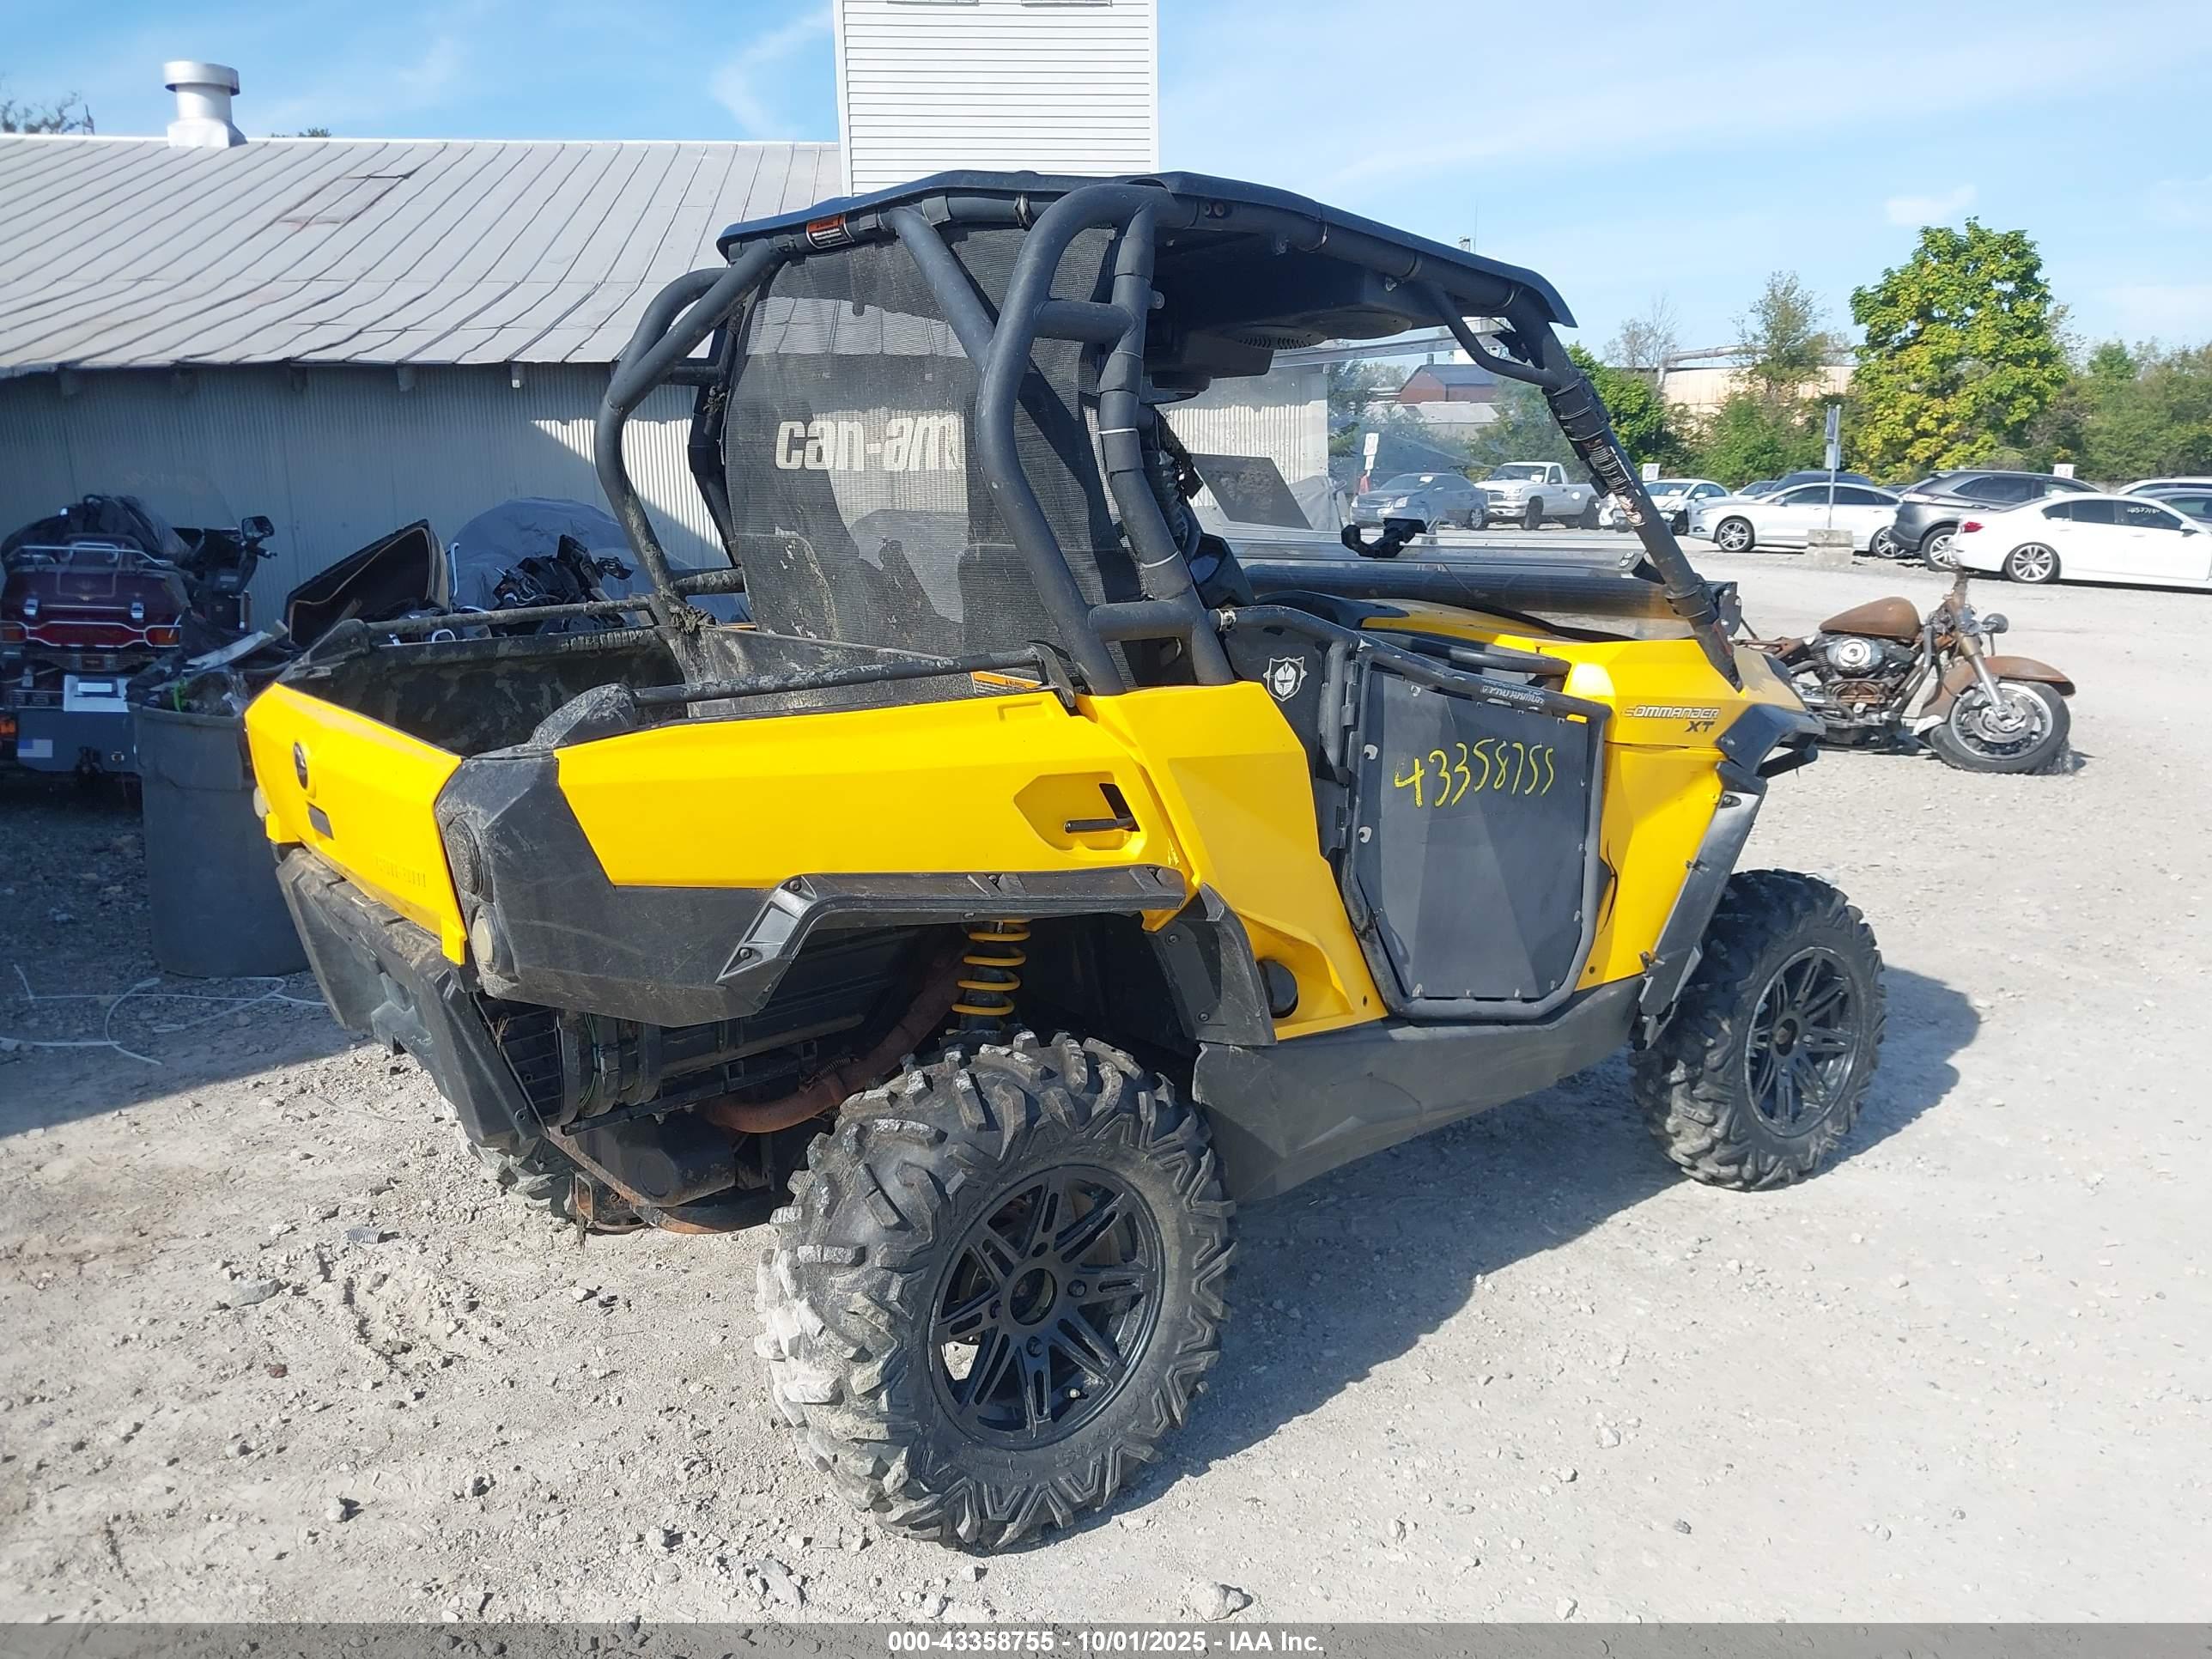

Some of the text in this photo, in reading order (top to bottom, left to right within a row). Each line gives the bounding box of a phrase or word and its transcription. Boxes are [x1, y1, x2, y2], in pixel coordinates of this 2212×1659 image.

[775, 415, 962, 472] can-am
[1622, 705, 1721, 720] COMMANDER
[1684, 720, 1716, 732] XT
[1393, 738, 1554, 810] 43358755
